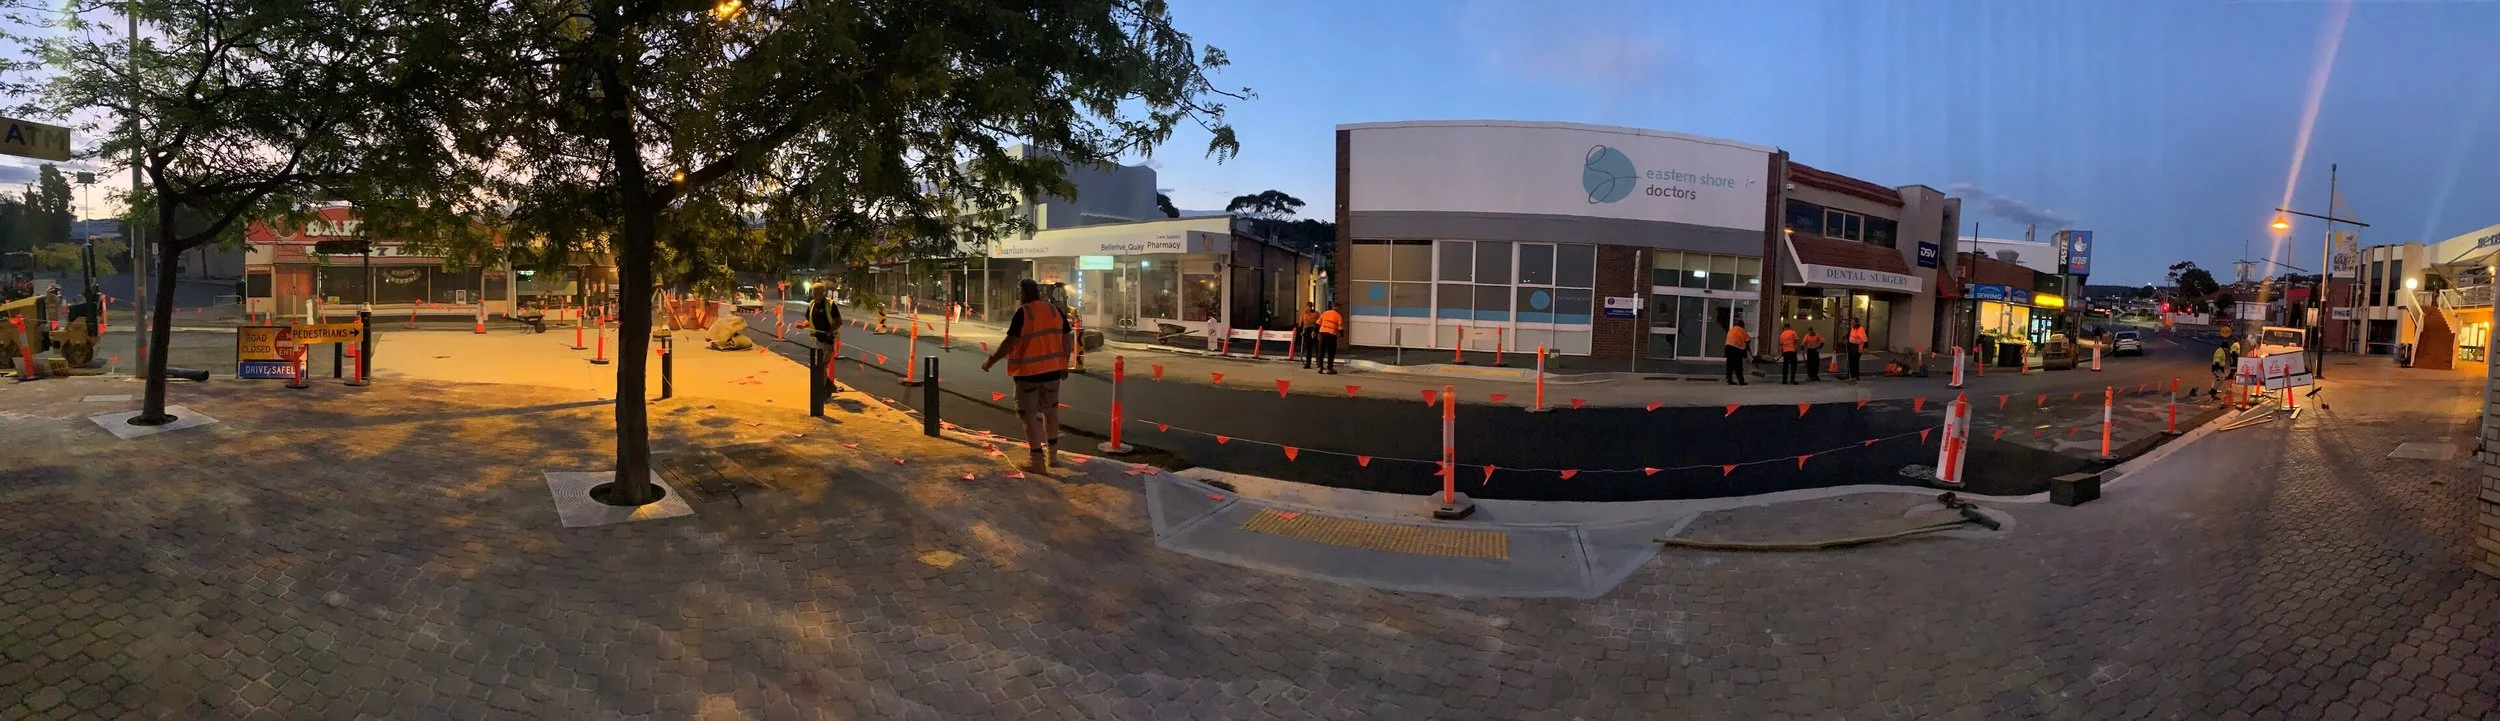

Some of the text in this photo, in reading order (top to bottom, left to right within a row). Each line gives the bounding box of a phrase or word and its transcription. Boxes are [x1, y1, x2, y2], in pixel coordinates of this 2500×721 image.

[5, 123, 65, 151] ATM
[1646, 169, 1735, 189] eastern shore
[1646, 184, 1697, 200] doctors
[1128, 243, 1145, 252] Quay
[1147, 241, 1181, 250] Pharmacy
[1920, 247, 1937, 258] DSV
[2060, 240, 2069, 265] TASTE
[1826, 268, 1908, 286] DENTAL SURGERY
[1976, 292, 2002, 300] SEWING
[247, 334, 266, 343] ROAD
[293, 328, 347, 339] PEDESTRIANS
[242, 345, 271, 354] CLOSED
[245, 365, 296, 375] DRIVE SAFEL
